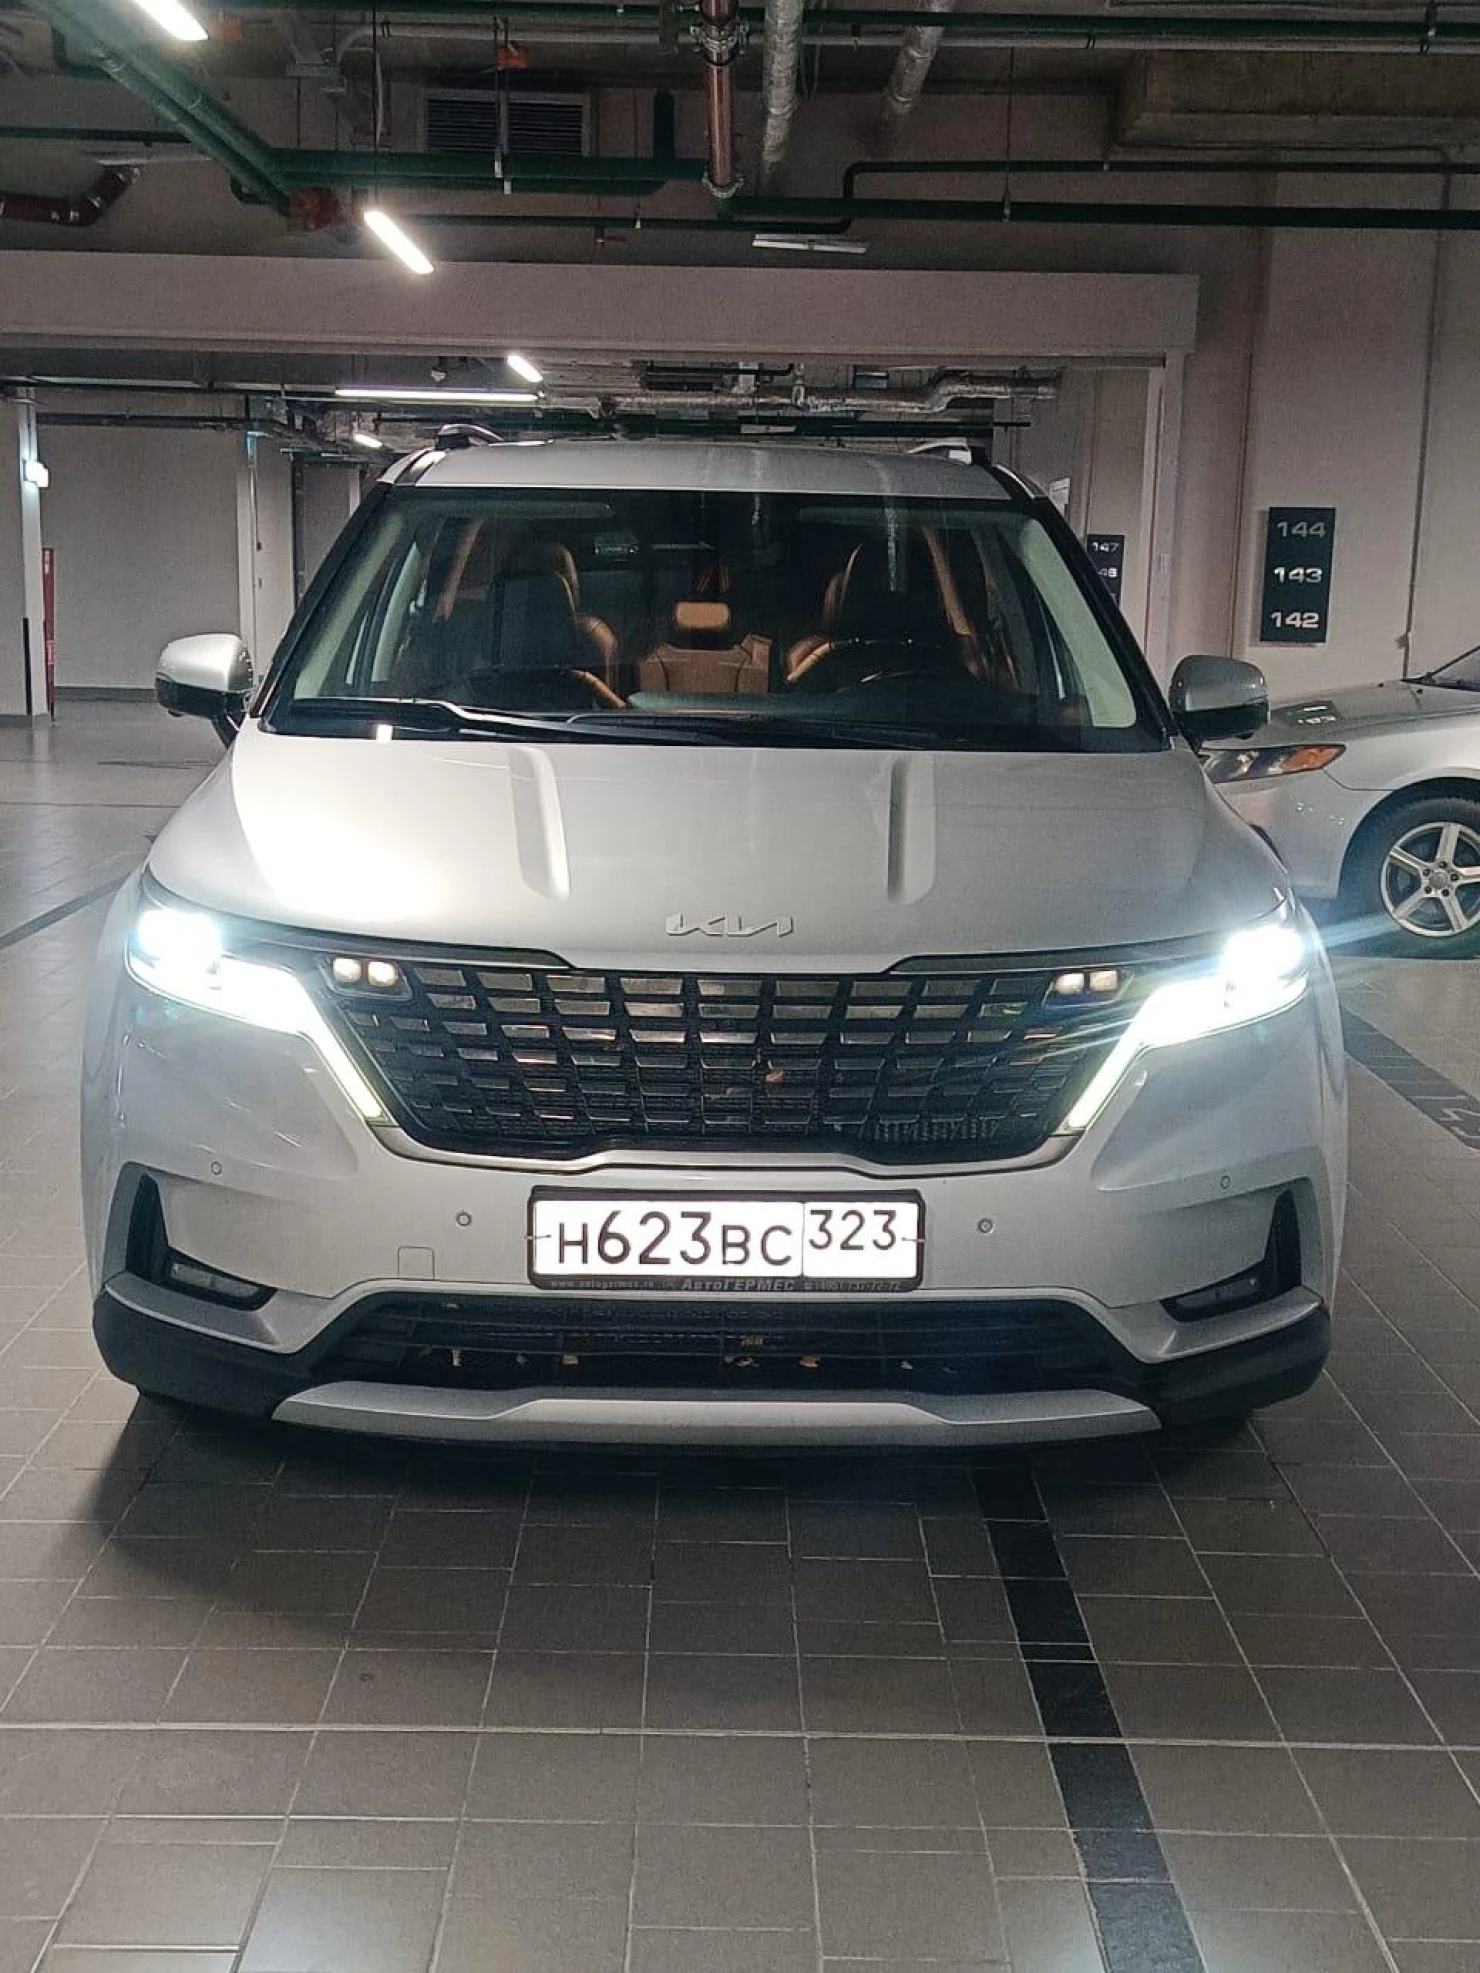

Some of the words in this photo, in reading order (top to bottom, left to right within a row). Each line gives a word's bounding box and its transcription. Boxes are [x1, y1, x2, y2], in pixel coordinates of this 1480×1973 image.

[1277, 521, 1326, 538] 144
[1274, 567, 1322, 583] 143
[1270, 612, 1319, 628] 142
[809, 1209, 897, 1251] 323
